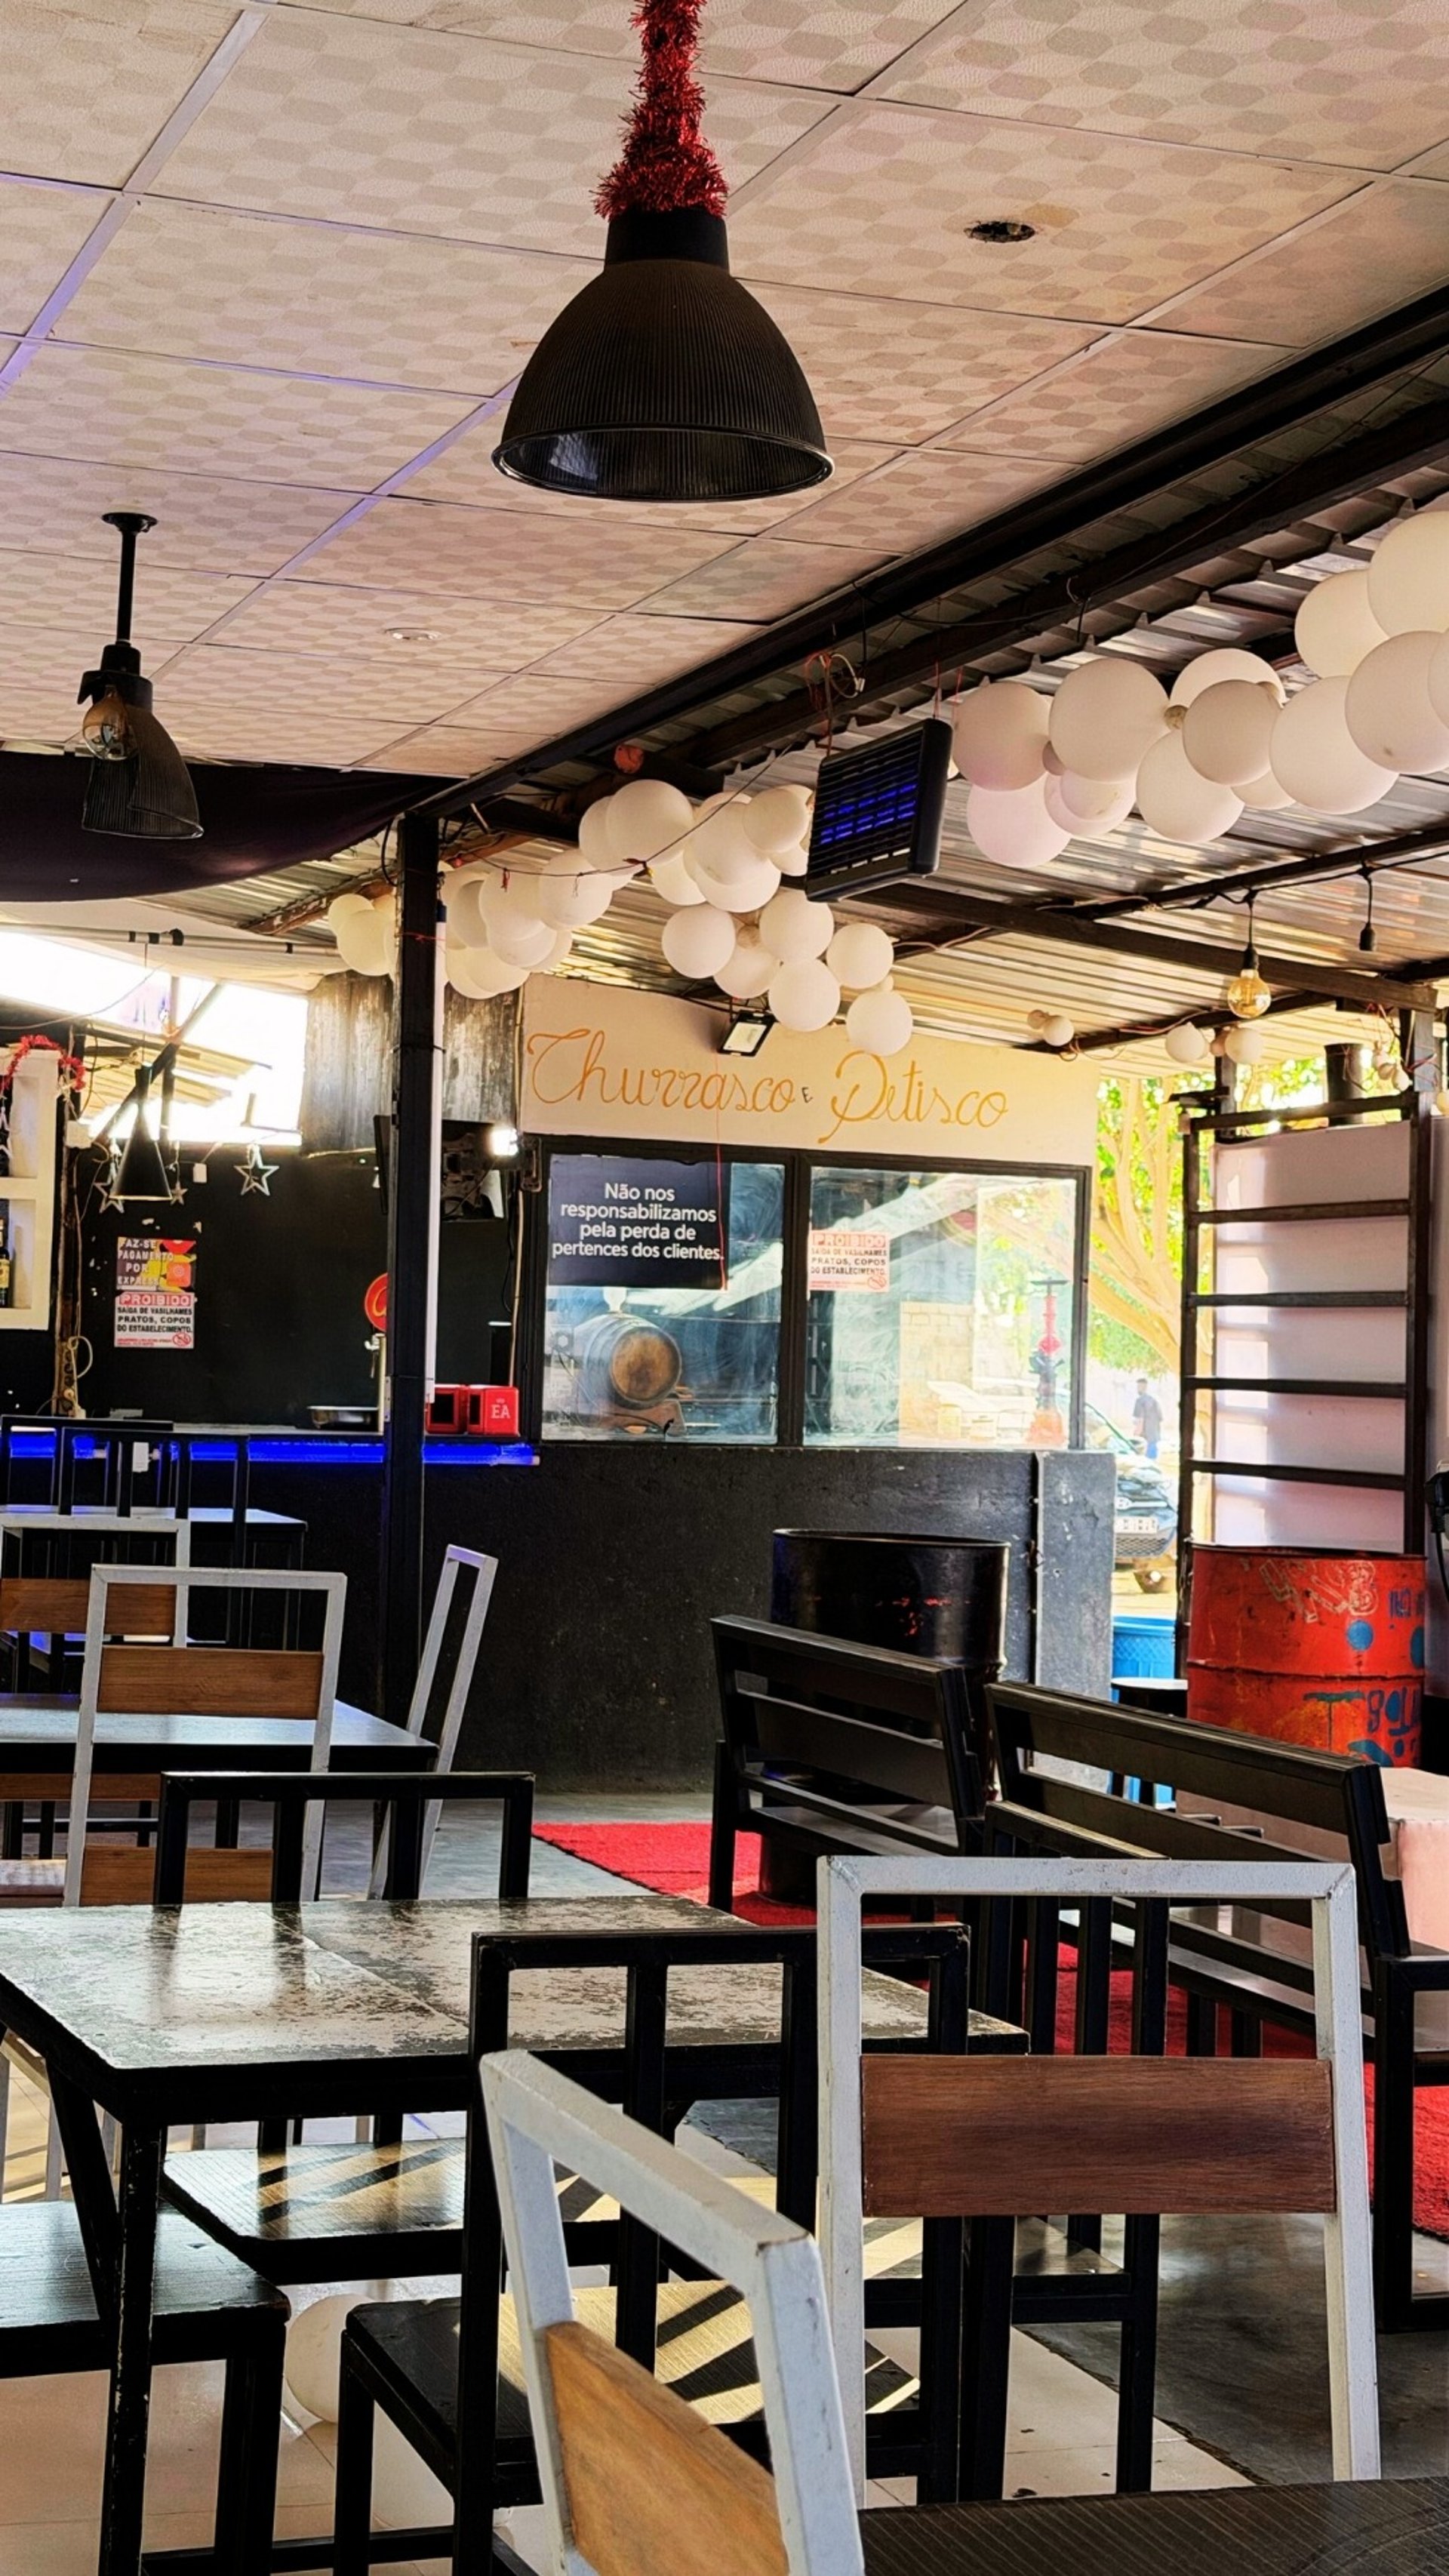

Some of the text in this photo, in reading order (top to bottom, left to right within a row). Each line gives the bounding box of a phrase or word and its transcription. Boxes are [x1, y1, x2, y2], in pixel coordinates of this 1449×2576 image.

[801, 1087, 813, 1103] E
[817, 1050, 1009, 1143] Petisco
[605, 1183, 675, 1202] Não nos
[561, 1203, 717, 1222] responsabilizamos
[580, 1221, 697, 1242] pela perda de
[814, 1233, 886, 1247] PROIBIDO
[118, 1250, 174, 1261] PAGAMENTO
[552, 1241, 724, 1260] pertences dos clientes.
[120, 1294, 190, 1306] PROIBIDO
[117, 1324, 127, 1332] DO
[118, 1316, 158, 1324] PRATOS,
